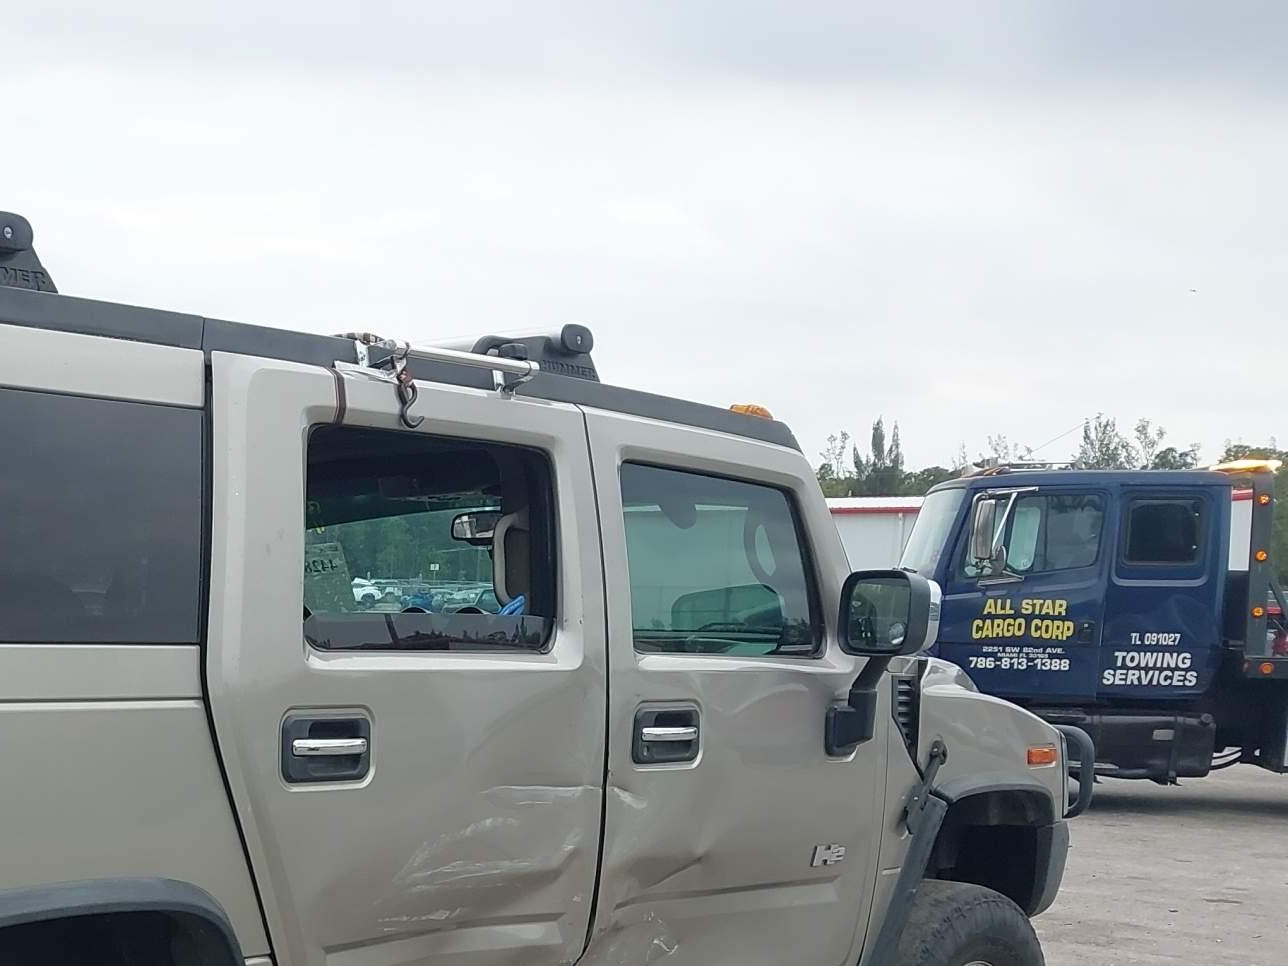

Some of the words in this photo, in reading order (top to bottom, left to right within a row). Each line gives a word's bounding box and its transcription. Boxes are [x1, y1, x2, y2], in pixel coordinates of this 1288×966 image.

[540, 359, 597, 381] HUMMER
[983, 599, 1015, 615] ALL
[1021, 599, 1067, 616] STAR
[972, 618, 1025, 639] CARGO
[1031, 619, 1074, 640] CORP
[1131, 633, 1142, 645] TL
[1144, 633, 1182, 646] 091027
[968, 657, 1070, 671] 786-813-1388
[1114, 652, 1192, 669] TOWING
[1102, 669, 1198, 686] SERVICES
[810, 844, 846, 867] H2
